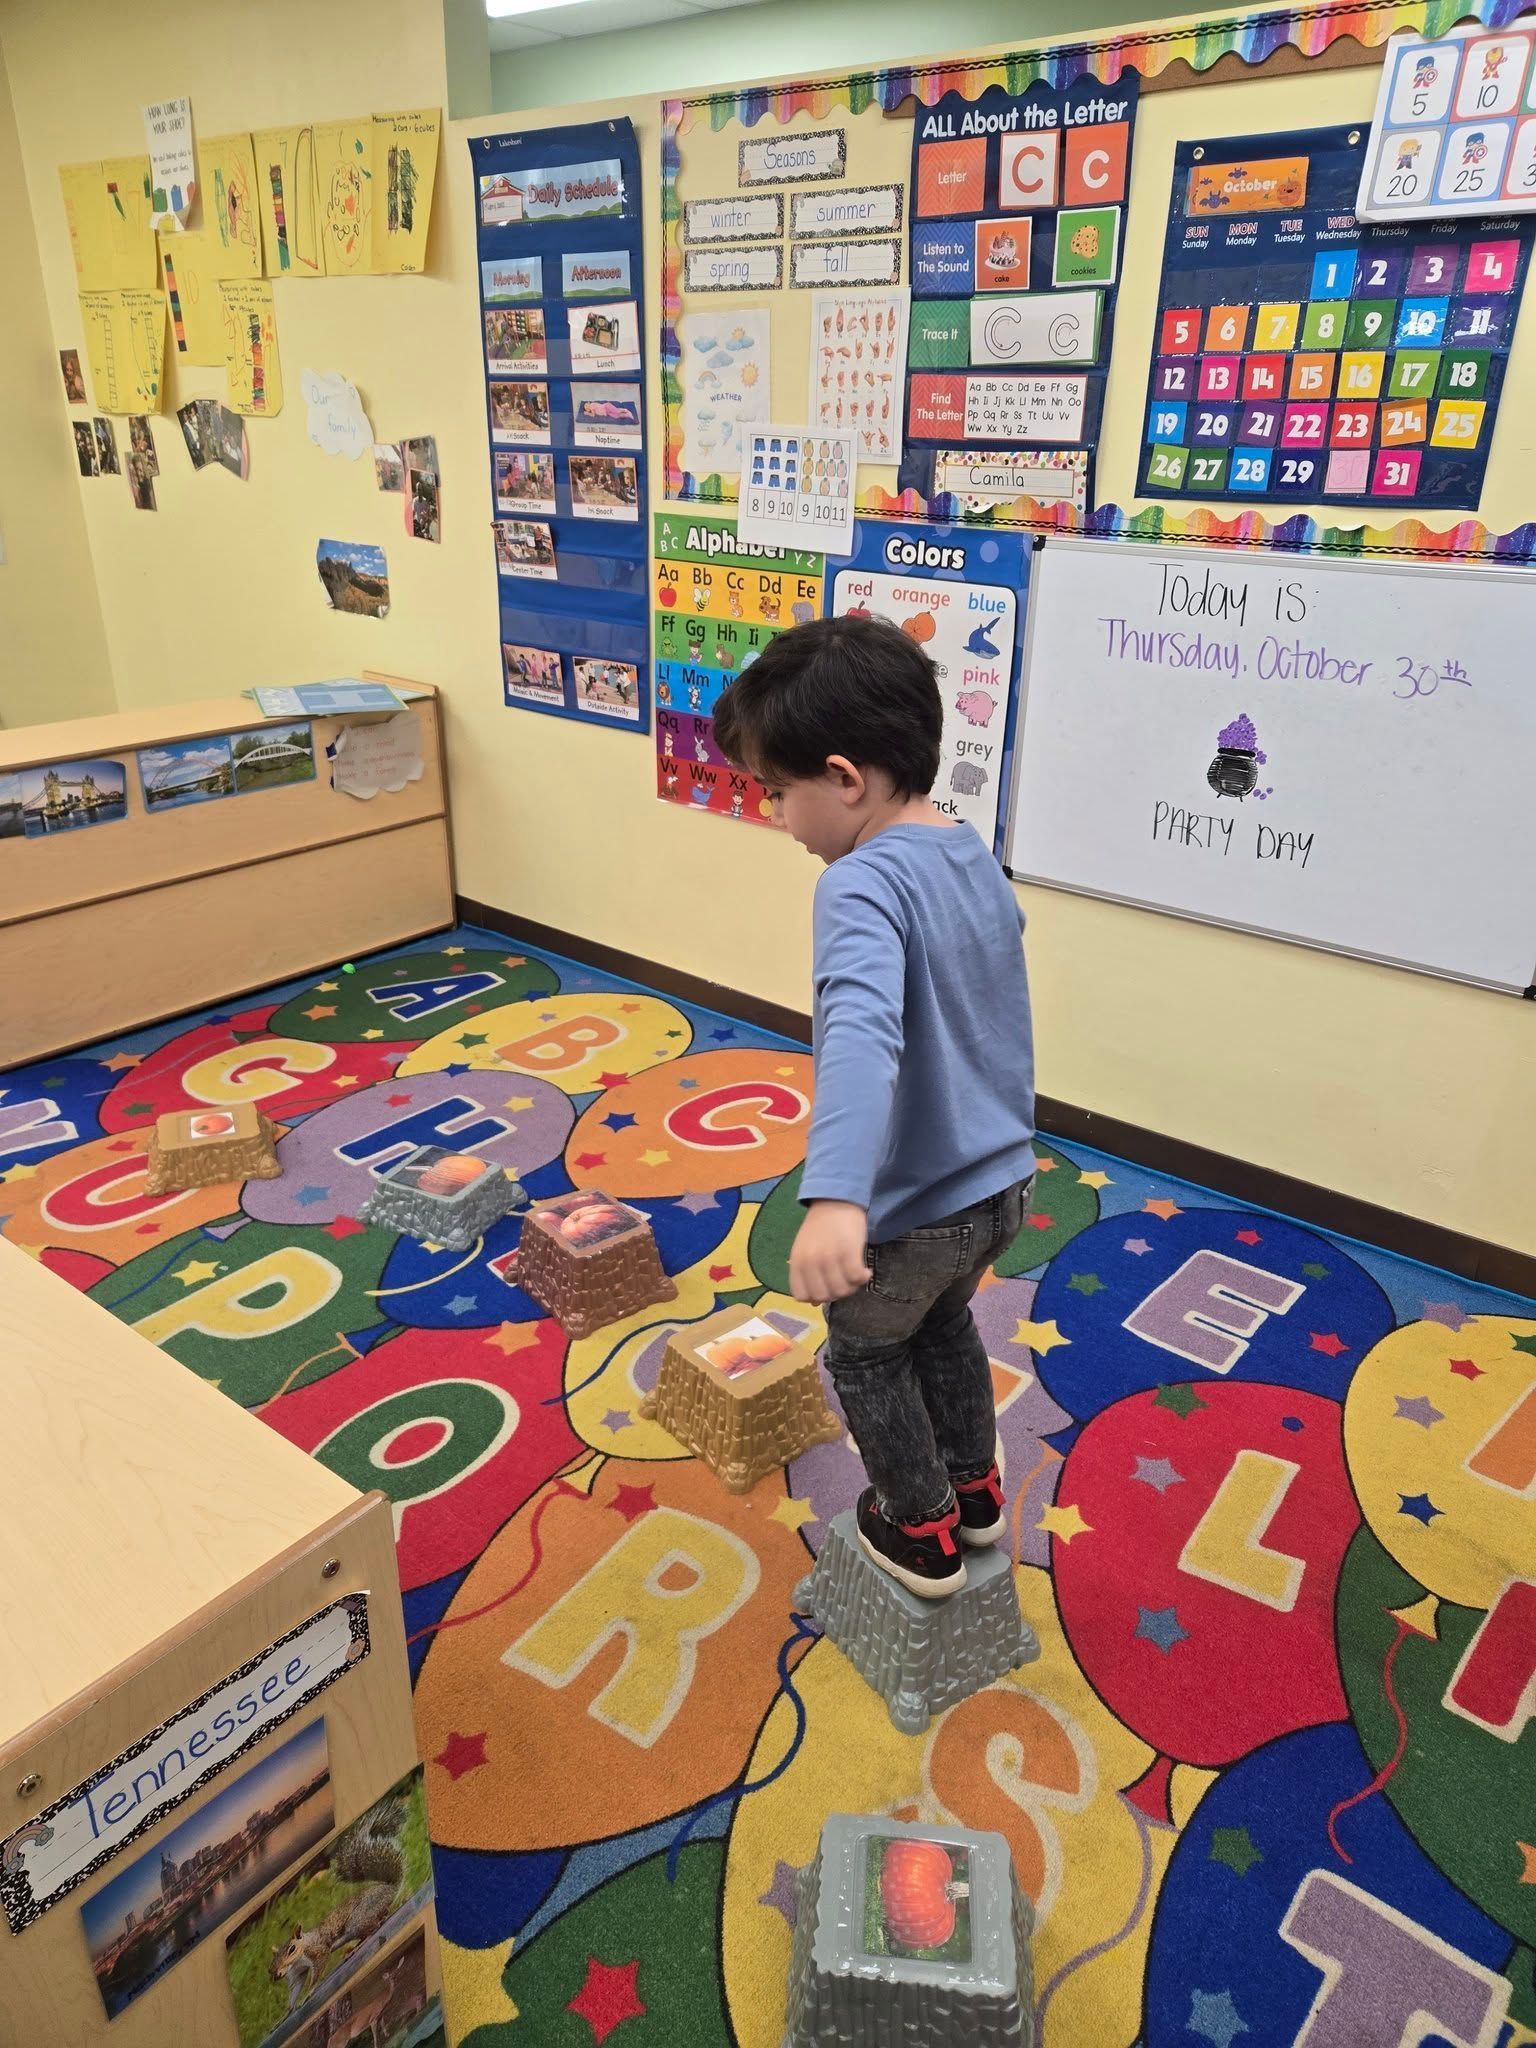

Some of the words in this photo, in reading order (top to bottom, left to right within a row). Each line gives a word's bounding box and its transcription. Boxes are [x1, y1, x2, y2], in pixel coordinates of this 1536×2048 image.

[1412, 92, 1429, 116] 5
[1476, 84, 1499, 109] 10
[922, 114, 956, 138] ALL
[961, 107, 1019, 135] About
[1024, 103, 1057, 128] the
[1064, 98, 1128, 126] Letter
[764, 143, 816, 169] Seasons
[938, 170, 968, 185] Letter
[1011, 145, 1045, 193] C
[1453, 168, 1485, 193] 25
[528, 181, 561, 207] Daily
[565, 175, 619, 202] Schedule
[1223, 178, 1279, 194] October
[1386, 174, 1418, 198] 20
[710, 208, 752, 228] winter
[817, 203, 876, 221] summer
[1327, 216, 1356, 230] WED
[1184, 225, 1209, 239] SUN
[1228, 222, 1258, 236] MON
[1280, 219, 1303, 232] TUE
[1315, 227, 1362, 241] Wednesday
[1371, 225, 1410, 239] Thursday
[1431, 223, 1458, 236] Friday
[1480, 219, 1521, 233] Saturday
[1182, 238, 1209, 251] Sunday
[1225, 235, 1258, 248] Monday
[1273, 231, 1306, 244] Tuesday
[823, 247, 849, 272] fall
[923, 243, 951, 256] Listen
[953, 243, 965, 255] to
[571, 266, 622, 282] Afternoon
[710, 260, 750, 283] spring
[918, 261, 936, 273] The
[937, 260, 970, 273] Sound
[1071, 267, 1097, 276] cookies
[1325, 264, 1337, 289] 1
[1367, 260, 1388, 286] 2
[1425, 257, 1443, 283] 3
[1483, 254, 1502, 280] 4
[493, 270, 531, 288] Morning
[984, 306, 1022, 359] C
[1174, 321, 1188, 344] 5
[1220, 317, 1236, 341] 6
[1270, 316, 1286, 339] 7
[1317, 313, 1334, 338] 8
[1364, 312, 1383, 336] 9
[1407, 311, 1437, 336] 10
[1470, 308, 1492, 334] 11
[922, 328, 948, 340] Trace
[949, 328, 958, 340] It
[596, 359, 615, 369] Lunch
[1399, 363, 1429, 387] 17
[1449, 362, 1477, 387] 18
[969, 382, 981, 392] Aa
[985, 382, 997, 392] Bb
[1001, 382, 1014, 392] Cc
[1017, 382, 1030, 392] Dd
[1034, 382, 1046, 393] Ee
[1050, 382, 1060, 393] Ff
[1065, 382, 1079, 395] Gg
[1162, 367, 1186, 390] 12
[1207, 367, 1230, 390] 13
[1251, 367, 1275, 390] 14
[1299, 366, 1323, 389] 15
[1346, 365, 1373, 389] 16
[311, 384, 328, 405] Our
[710, 392, 742, 402] WEATHER
[931, 393, 951, 405] Find
[917, 408, 936, 420] The
[936, 408, 963, 421] Letter
[1156, 413, 1179, 435] 19
[1199, 413, 1229, 436] 20
[1247, 412, 1273, 436] 21
[1336, 414, 1369, 438] 23
[1386, 410, 1421, 435] 24
[1438, 412, 1475, 437] 25
[1288, 414, 1321, 439] 22
[595, 435, 621, 445] Naptime
[969, 466, 1025, 488] Camila
[1153, 454, 1182, 480] 26
[1193, 459, 1223, 482] 27
[1236, 458, 1266, 482] 28
[1279, 459, 1315, 484] 29
[1383, 461, 1411, 486] 31
[752, 499, 760, 512] 8
[768, 500, 775, 513] 9
[780, 502, 793, 516] 10
[802, 504, 809, 517] 9
[816, 505, 830, 519] 10
[832, 507, 846, 521] 11
[885, 536, 966, 570] Colors
[658, 564, 679, 582] Aa
[693, 568, 712, 585] Bb
[726, 572, 745, 590] Cc
[759, 576, 782, 595] Dd
[797, 580, 816, 599] Ee
[847, 580, 873, 597] red
[1149, 563, 1248, 627] Today
[892, 587, 951, 610] orange
[968, 592, 1006, 614] blue
[662, 616, 675, 633] Ff
[686, 620, 706, 643] Gg
[717, 624, 737, 643] Hh
[749, 628, 759, 646] Ii
[658, 664, 670, 681] Ll
[682, 668, 710, 688] Mm
[963, 667, 1000, 687] pink
[1257, 635, 1373, 686] October
[1393, 656, 1472, 698] 30th
[609, 706, 630, 716] Activity
[658, 711, 680, 734] Qq
[694, 718, 709, 735] Rr
[956, 738, 993, 762] grey
[660, 758, 678, 776] Vv
[689, 763, 717, 784] Ww
[729, 772, 748, 792] Xx
[1153, 801, 1234, 855] PARTY
[1257, 823, 1314, 868] DAY
[366, 971, 507, 1022] A
[493, 1015, 627, 1072] B
[664, 1081, 811, 1151] C
[1122, 1249, 1307, 1374] E
[1177, 1450, 1306, 1612] L
[500, 1505, 761, 1750] R
[67, 1656, 311, 1839] Tennessee
